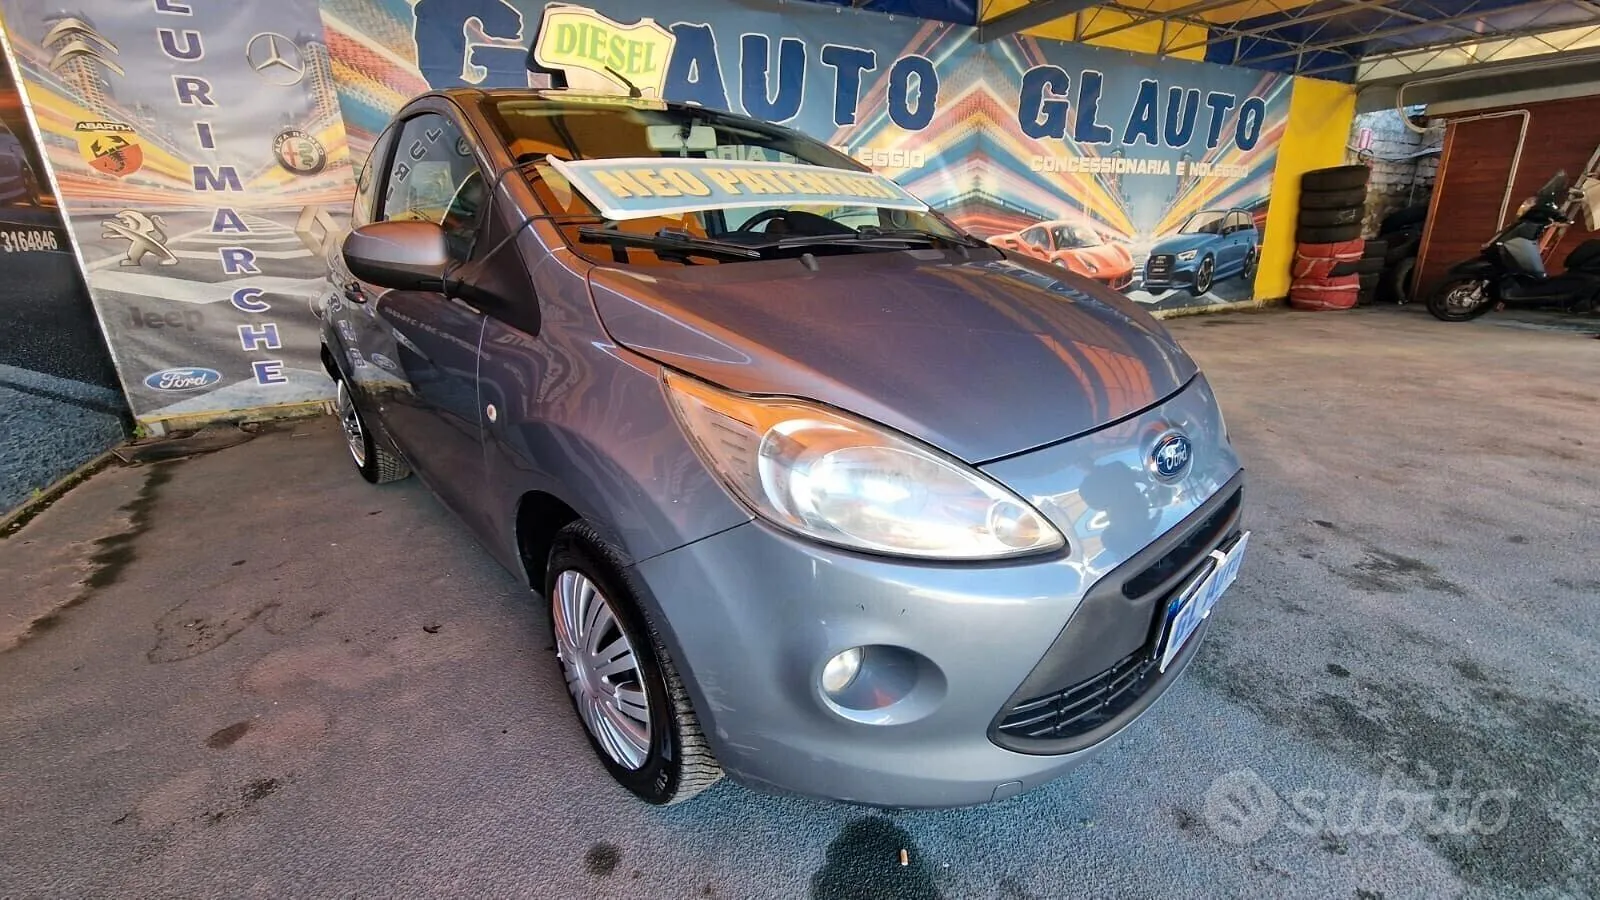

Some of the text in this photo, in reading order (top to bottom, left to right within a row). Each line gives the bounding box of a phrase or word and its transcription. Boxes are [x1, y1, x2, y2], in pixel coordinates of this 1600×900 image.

[554, 22, 657, 75] DIESEL
[412, 0, 940, 132] G AUTO
[1018, 64, 1266, 152] GL AUTO
[77, 122, 136, 132] ABARTH
[857, 146, 925, 169] EGGIO
[1030, 155, 1250, 178] CONCESSIONARIA E NOLEGGIO
[590, 167, 712, 198] NEO
[1, 230, 58, 253] 3164846
[125, 306, 205, 332] Jeep
[158, 370, 210, 389] Ford
[1161, 439, 1188, 470] Ford
